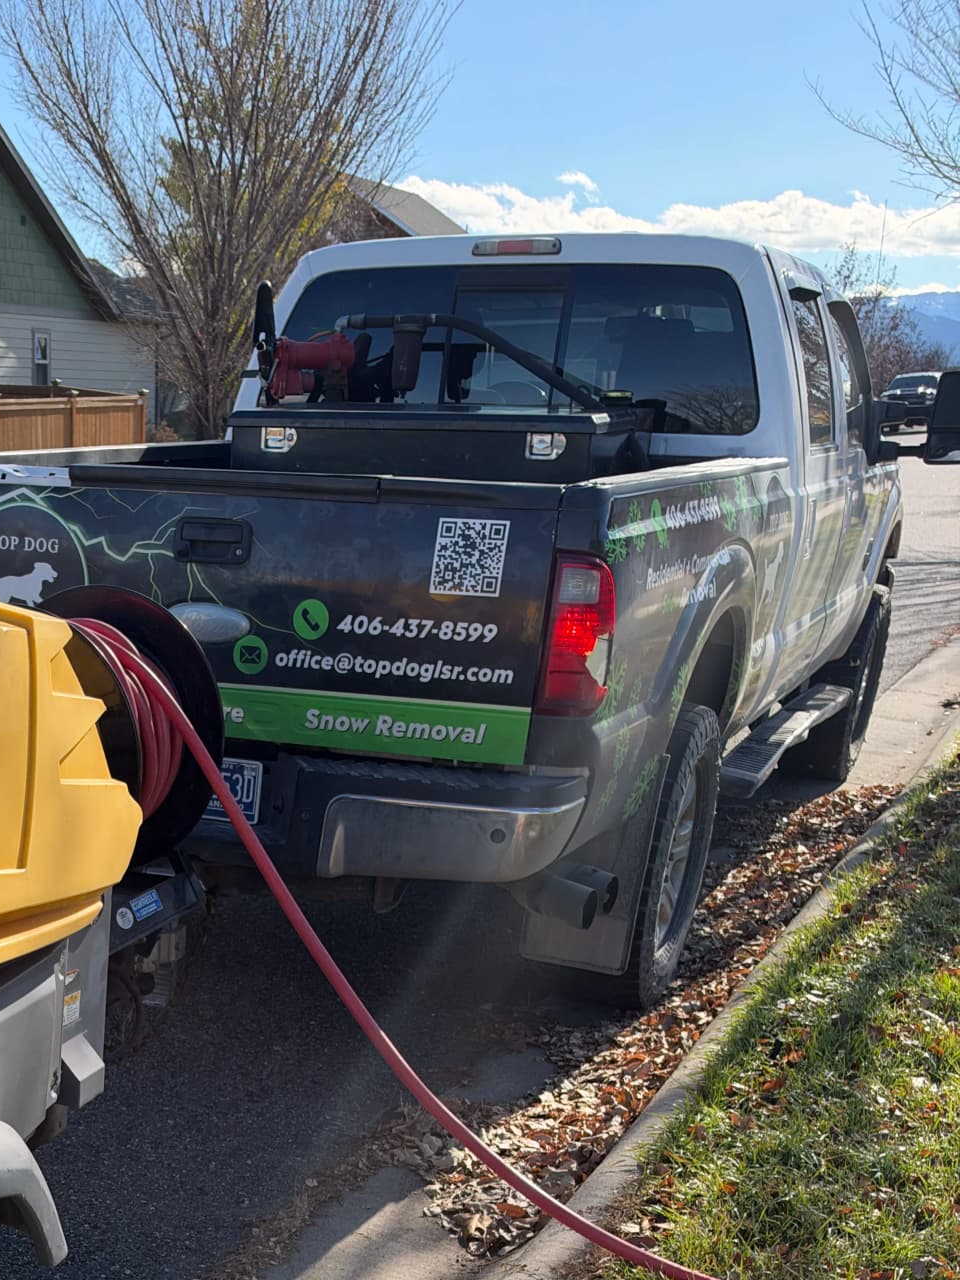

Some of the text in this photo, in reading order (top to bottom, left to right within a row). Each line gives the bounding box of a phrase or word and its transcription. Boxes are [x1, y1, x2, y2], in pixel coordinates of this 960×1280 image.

[24, 537, 59, 553] DOG
[337, 614, 499, 643] 406-437-8599
[275, 649, 514, 685] office@topdoglsr.com
[304, 708, 487, 745] Snow Removal
